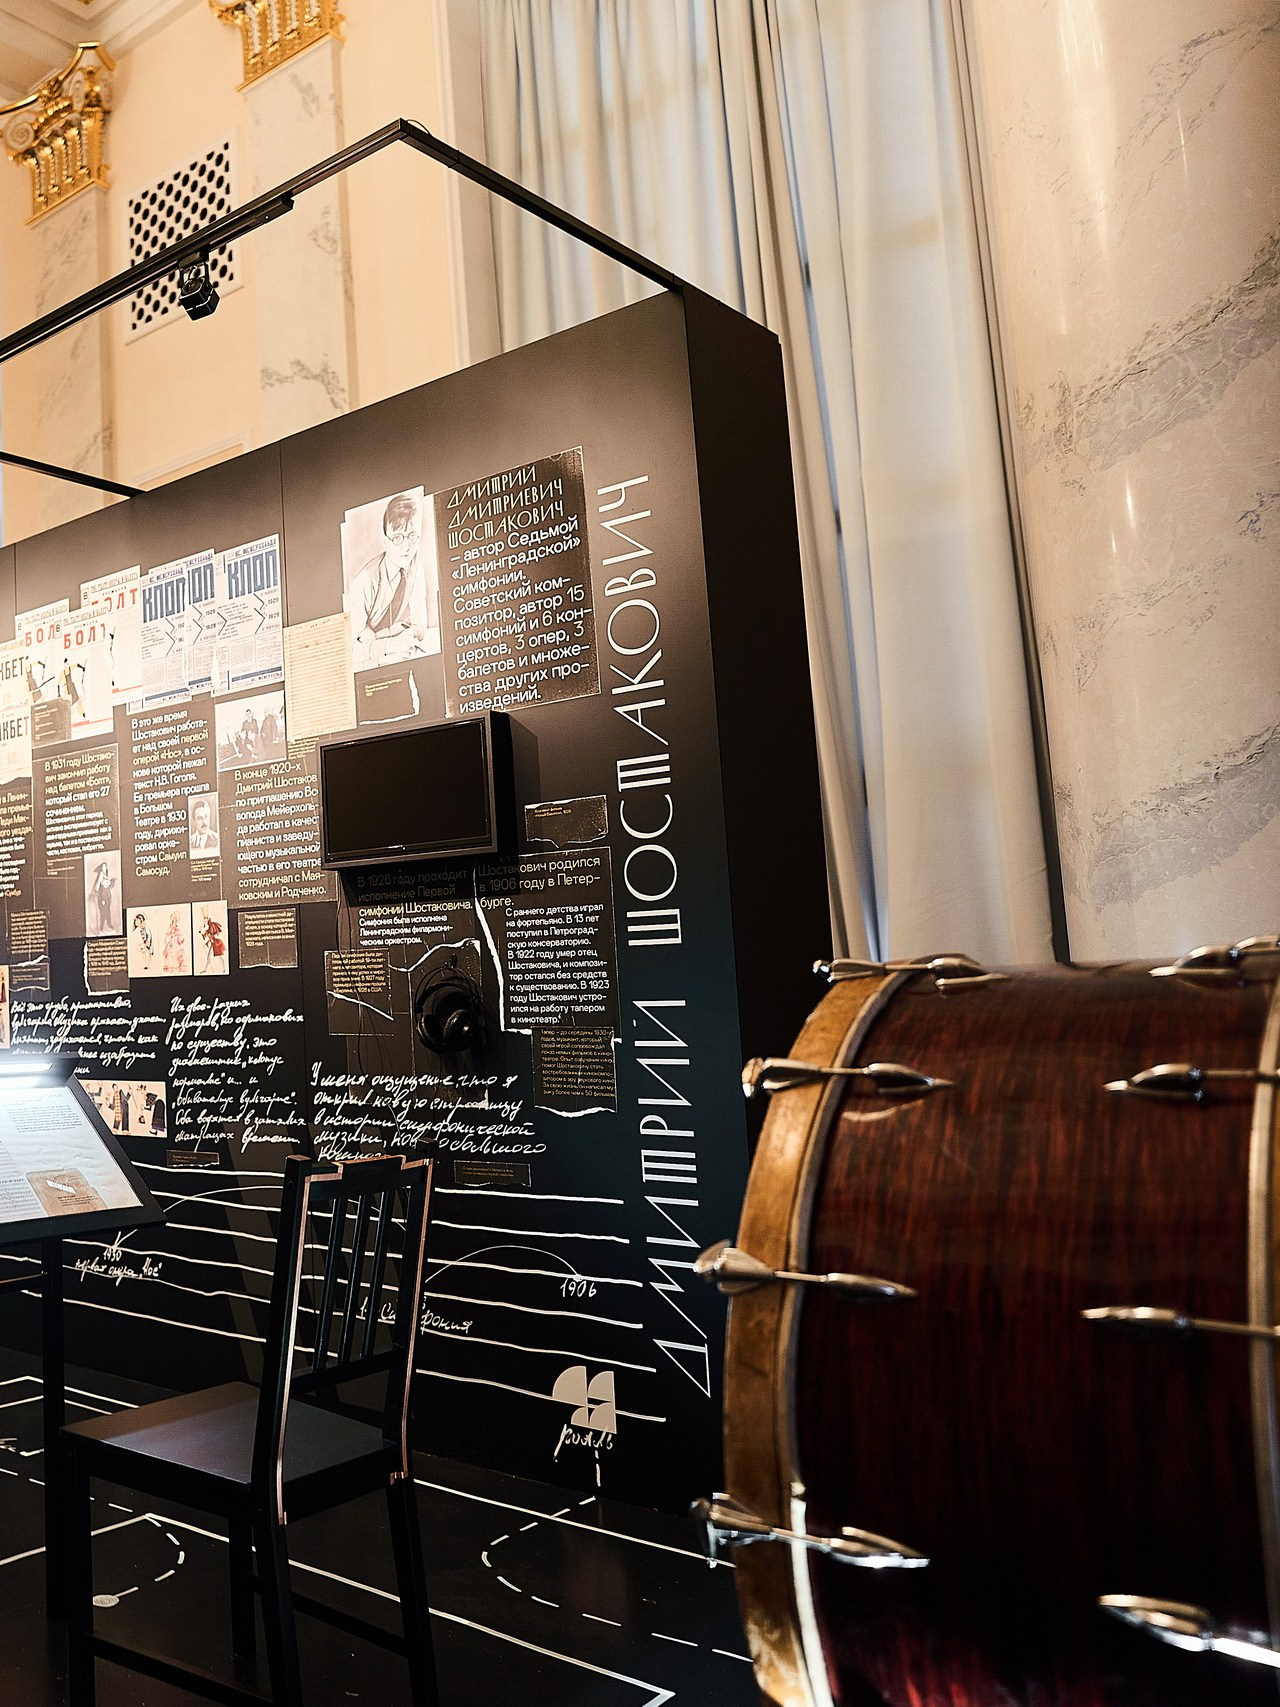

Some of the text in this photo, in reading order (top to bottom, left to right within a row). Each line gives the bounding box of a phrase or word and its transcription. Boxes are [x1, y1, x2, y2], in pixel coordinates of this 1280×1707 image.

[447, 465, 536, 508] ДМИТРИЙ
[448, 478, 563, 529] ДМИТРИЕВИЧ
[448, 500, 564, 549] ШОСТАКОВИЧ
[464, 516, 579, 562] автор Седьмой
[452, 534, 581, 578] «Ленинградской»
[228, 549, 278, 600] КЛОП
[452, 571, 527, 597] симфонии.
[453, 581, 531, 613] Советский
[455, 586, 585, 630] позитор, автор 15
[456, 616, 526, 646] симфоний
[529, 617, 539, 629] и
[543, 610, 552, 626] 6
[456, 622, 584, 665] цертов, 3 опер, 3
[458, 657, 516, 680] балетов
[519, 654, 528, 666] и
[459, 679, 492, 696] ства
[495, 668, 548, 691] других
[459, 685, 541, 713] изведений.
[235, 768, 267, 780] В конце
[236, 777, 272, 795] Дмитрий
[236, 789, 303, 807] по приглашению
[236, 809, 265, 820] волода
[237, 819, 290, 834] да работал в
[237, 835, 281, 847] пианиста и
[238, 841, 321, 861] ющего музыкальной
[238, 861, 290, 873] частью в его
[478, 857, 600, 876] Шостакович родился
[239, 874, 293, 888] сотрудничал
[358, 870, 467, 887] В 1926 году проходит
[488, 878, 555, 891] 1906 году в
[239, 886, 326, 900] ковским Родченко.
[359, 883, 455, 901] исполнение Первой
[406, 901, 473, 913] Шостаковича.
[480, 895, 514, 909] бурге.
[506, 904, 603, 918] С раннего детства играл
[517, 917, 565, 928] фортепьяно.
[566, 915, 572, 923] В
[574, 914, 583, 923] 13
[507, 930, 542, 938] поступил
[597, 475, 711, 1398] ДМИТРИЙ ШОСТАКОВИЧ
[508, 938, 591, 949] скую консерваторию.
[508, 949, 597, 959] В 1922 году умер отец
[508, 961, 561, 969] Шостаковича,
[509, 973, 522, 981] тор
[557, 969, 571, 978] без
[573, 971, 607, 980] средств
[516, 983, 579, 992] существованию.
[581, 980, 586, 988] В
[589, 980, 609, 988] 1923
[510, 992, 577, 1003] году Шостакович
[541, 1003, 568, 1013] работу
[570, 1005, 605, 1013] тапером
[559, 1280, 597, 1298] 1906
